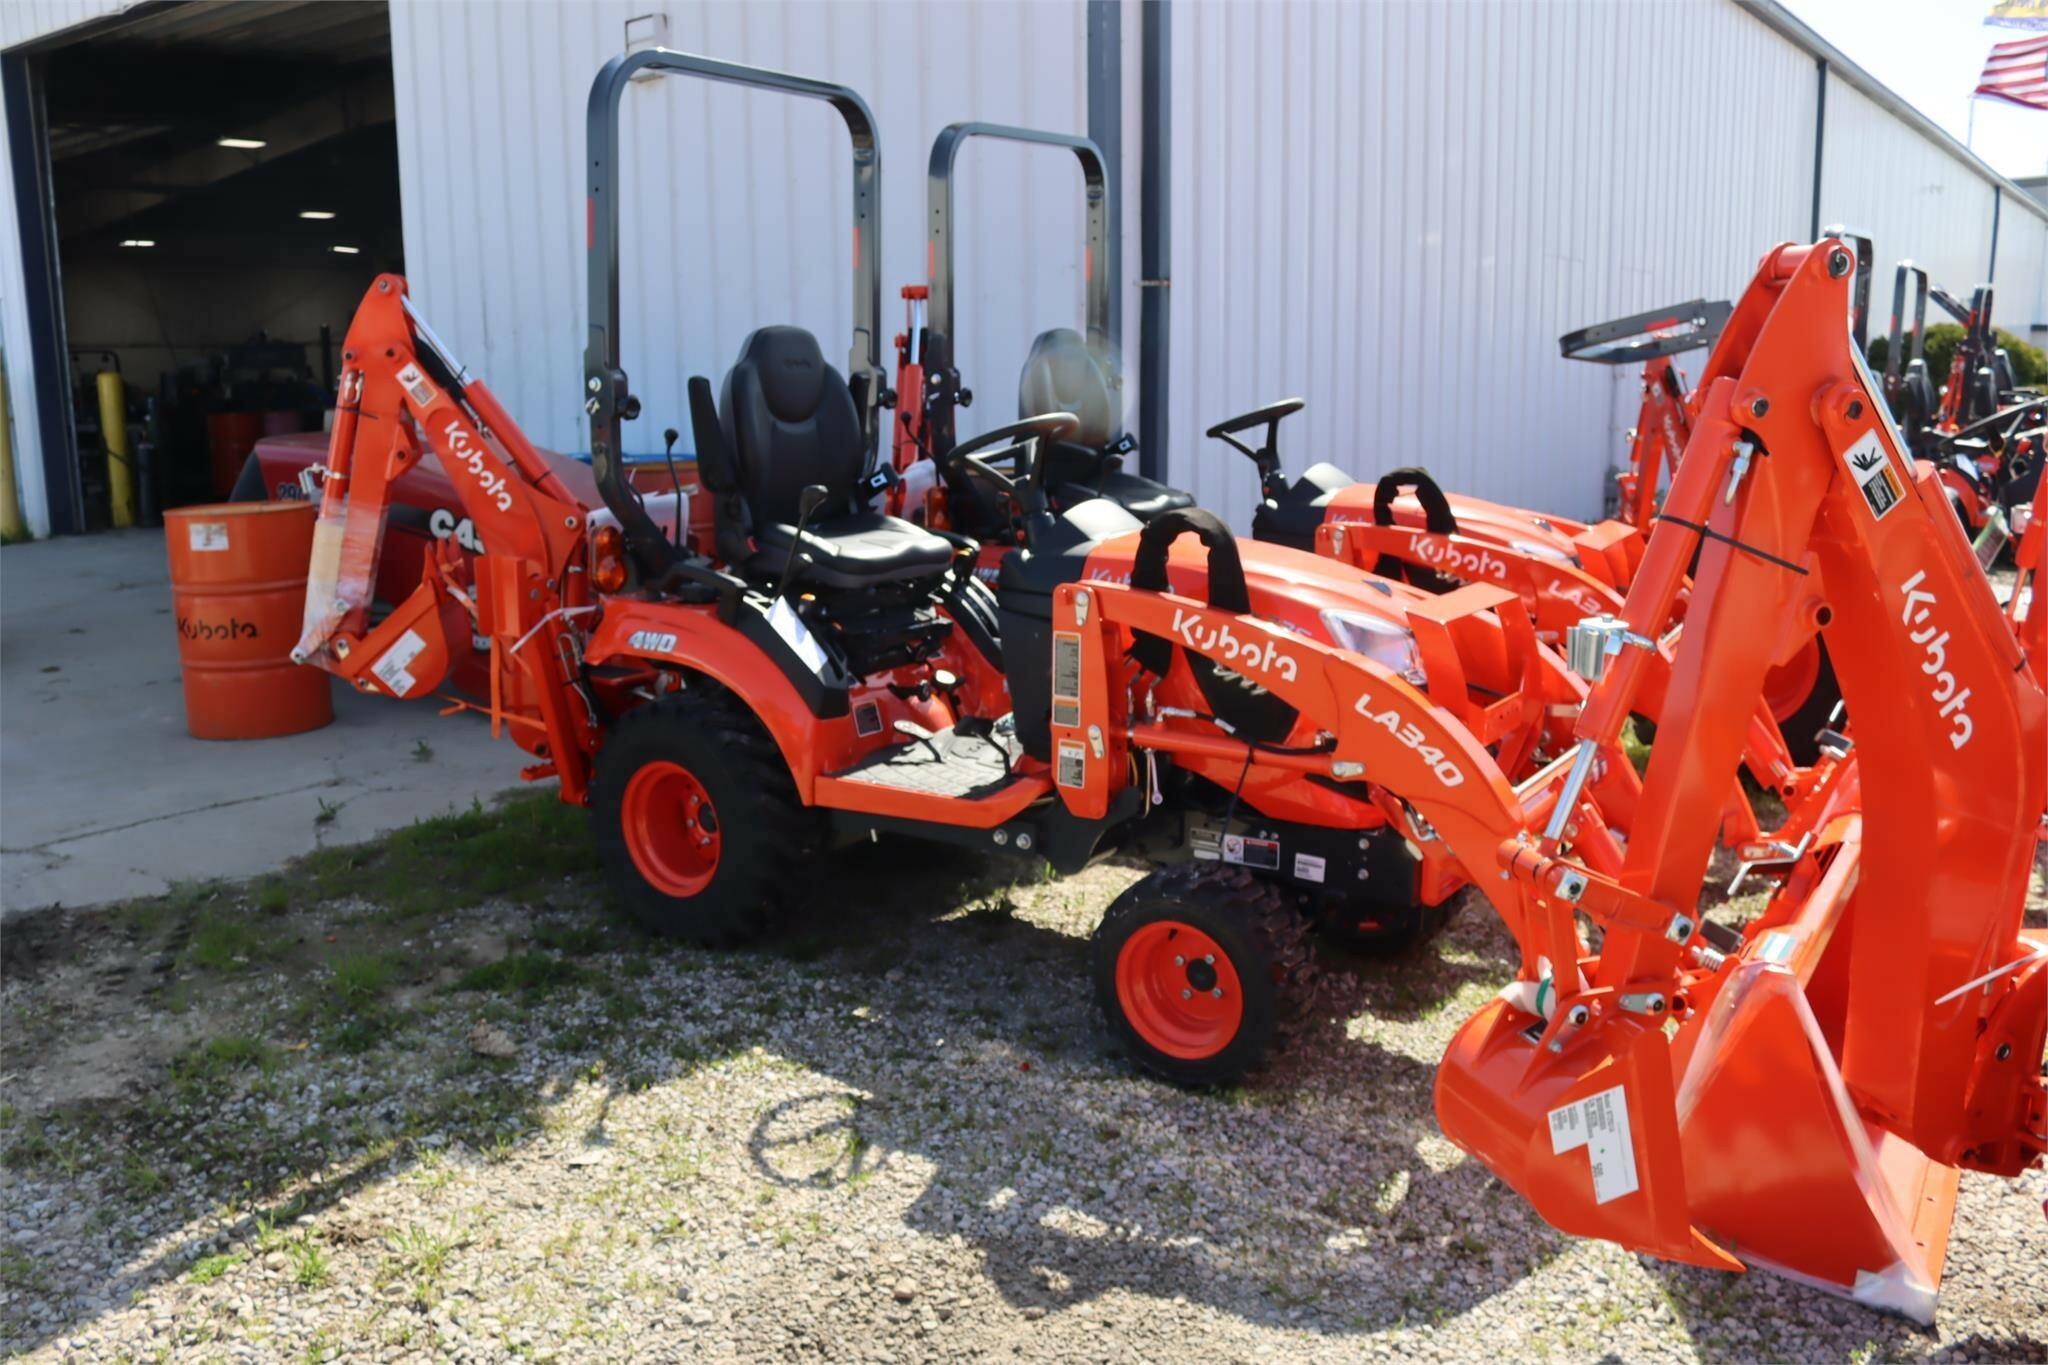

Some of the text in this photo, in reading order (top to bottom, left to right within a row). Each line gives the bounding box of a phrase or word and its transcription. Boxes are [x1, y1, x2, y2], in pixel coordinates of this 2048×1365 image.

[444, 420, 513, 512] Kubota
[1409, 534, 1507, 579] Kubota
[1548, 579, 1603, 616] LA3
[177, 617, 258, 639] Kubota
[628, 630, 678, 653] 4WD
[1172, 608, 1298, 682] Kubota
[1900, 569, 1973, 751] Kubota
[1354, 693, 1465, 787] LA340
